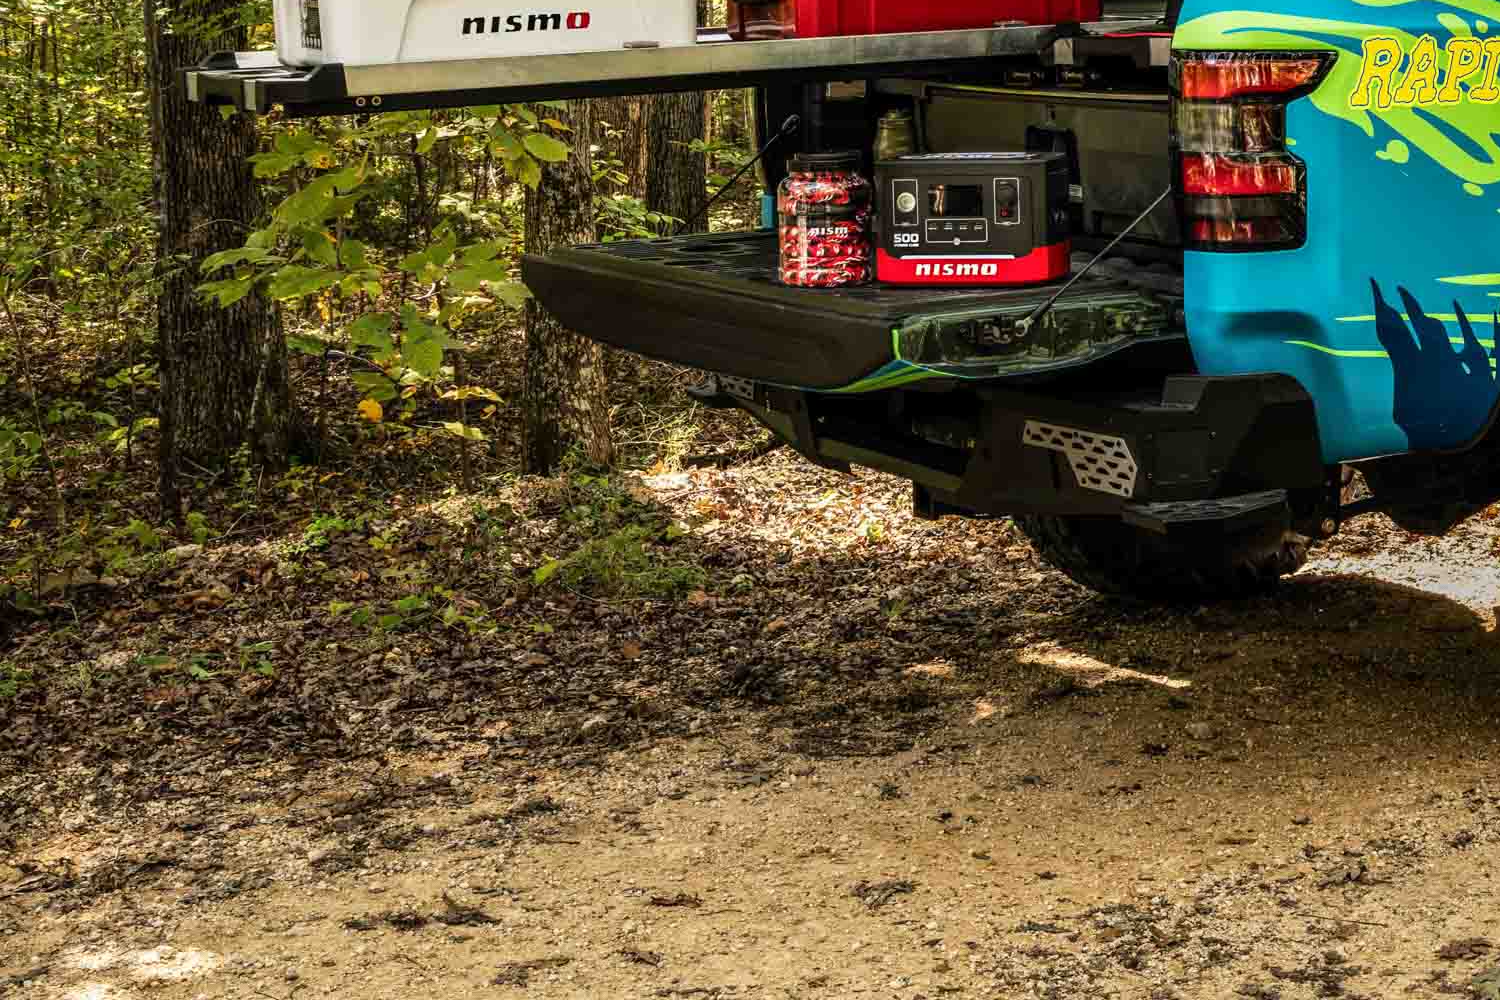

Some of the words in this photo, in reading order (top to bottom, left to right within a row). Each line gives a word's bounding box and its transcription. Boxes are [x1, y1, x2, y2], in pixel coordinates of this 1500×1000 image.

[462, 12, 591, 35] nismo
[810, 226, 849, 237] nism
[893, 232, 920, 243] 500
[915, 262, 998, 277] nismo
